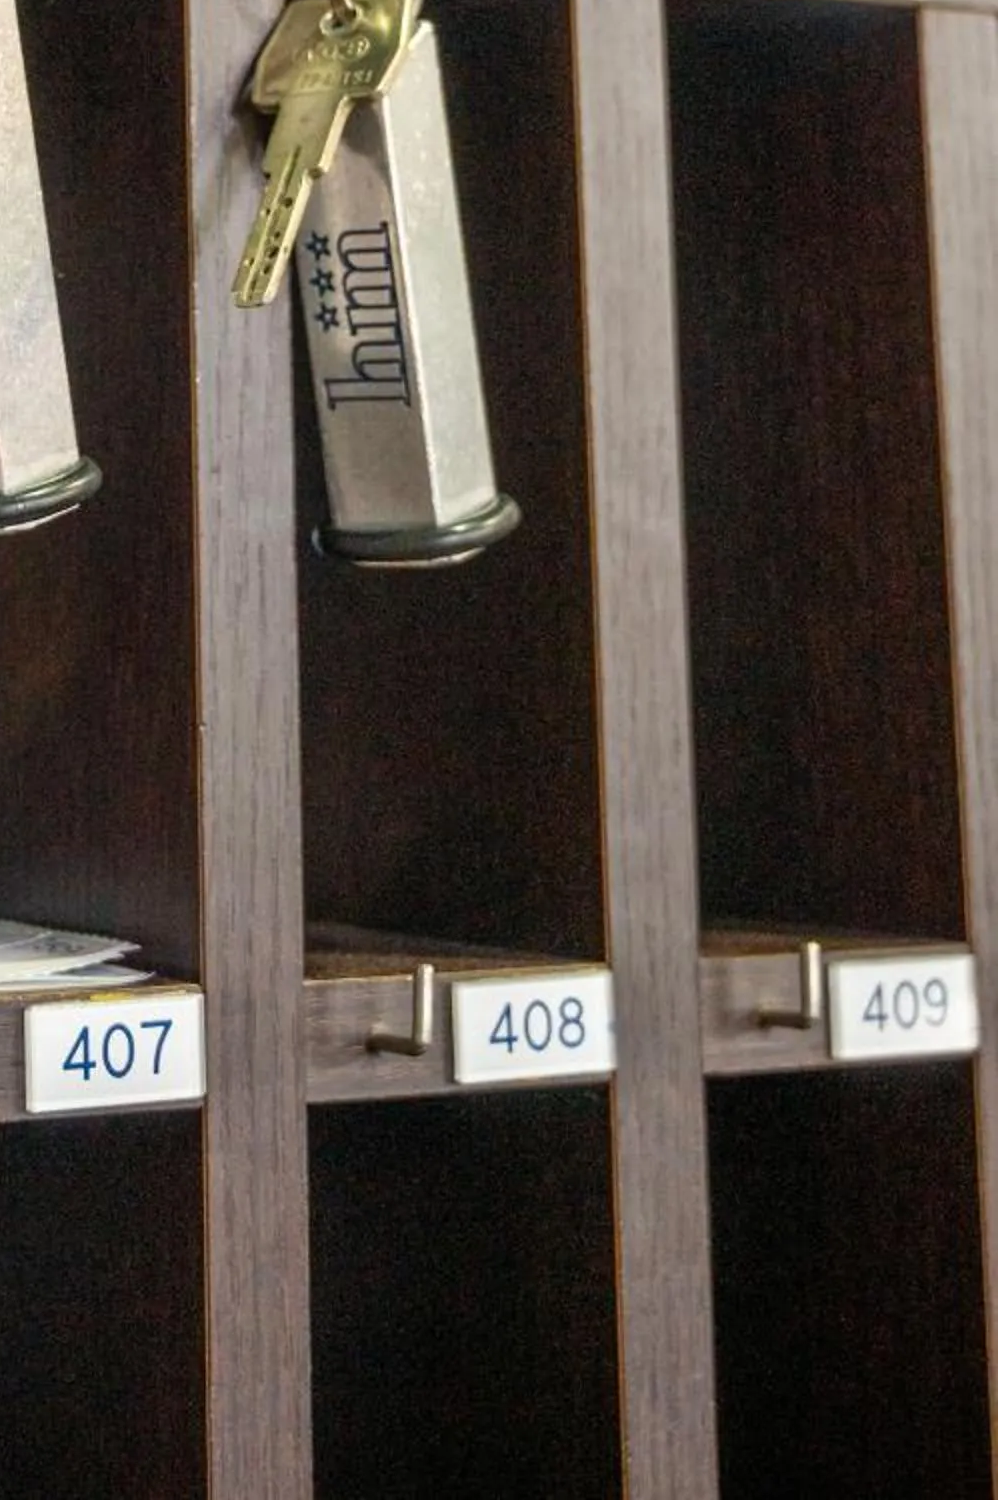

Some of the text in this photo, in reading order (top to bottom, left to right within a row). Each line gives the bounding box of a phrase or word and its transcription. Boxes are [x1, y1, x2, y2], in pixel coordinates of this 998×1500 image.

[488, 996, 586, 1055] 408
[861, 977, 950, 1032] 409
[61, 1018, 174, 1083] 407
